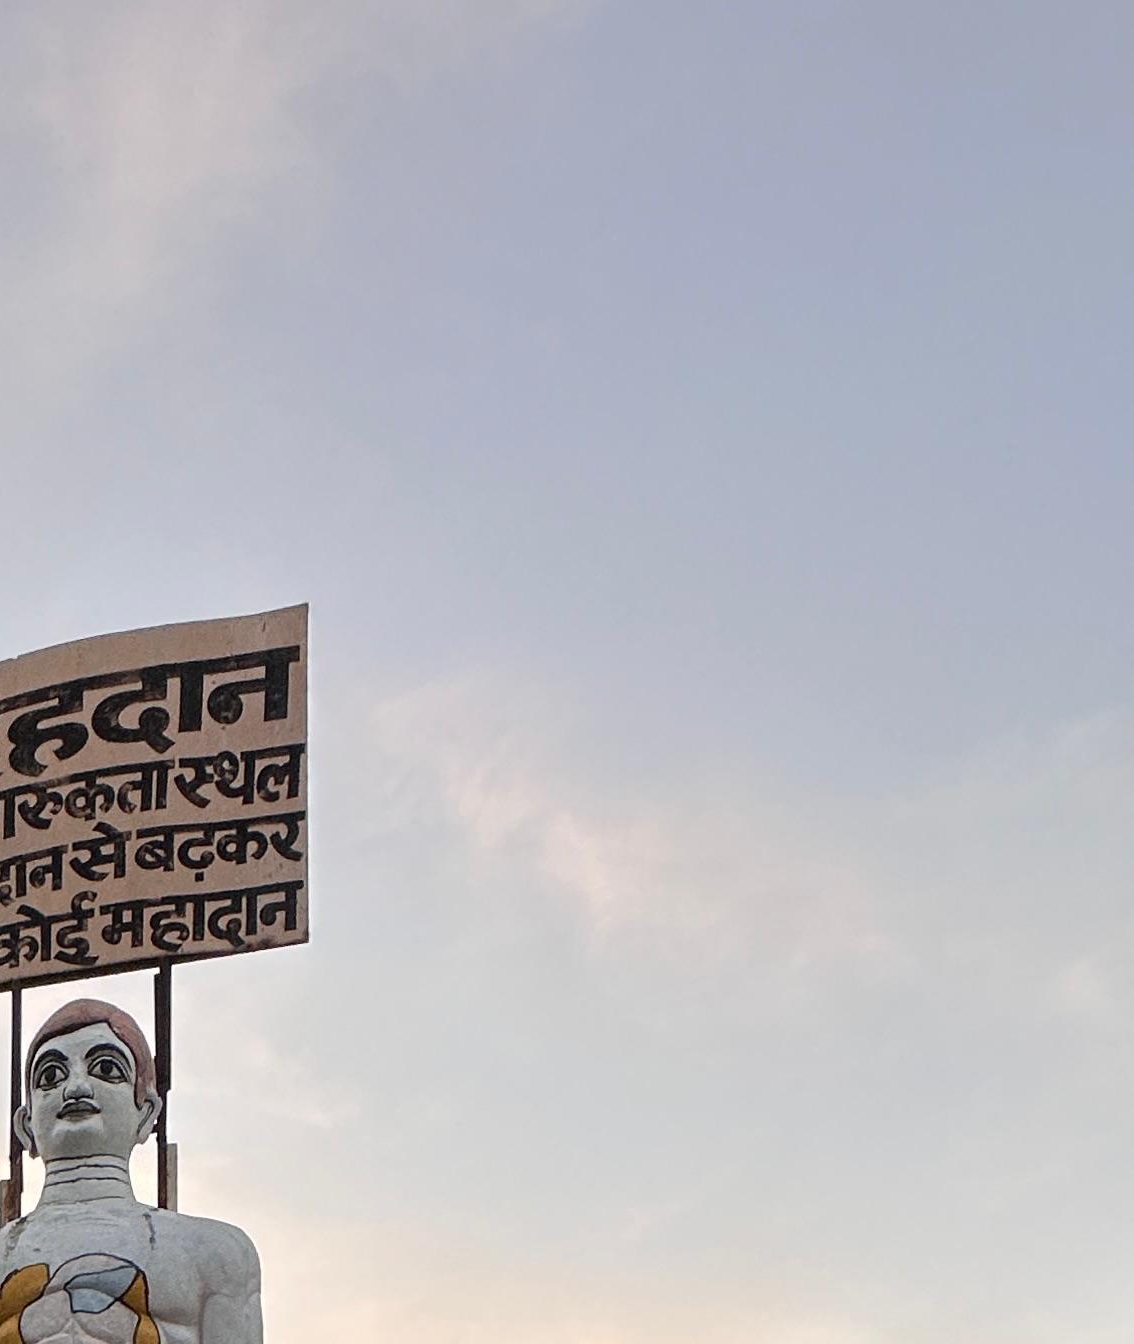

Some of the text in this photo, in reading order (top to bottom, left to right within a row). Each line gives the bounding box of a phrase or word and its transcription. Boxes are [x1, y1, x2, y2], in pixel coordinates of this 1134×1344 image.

[174, 743, 306, 808] स्थल
[69, 822, 132, 881] से
[135, 811, 306, 882] बढ़कर
[99, 879, 304, 952] महादान
